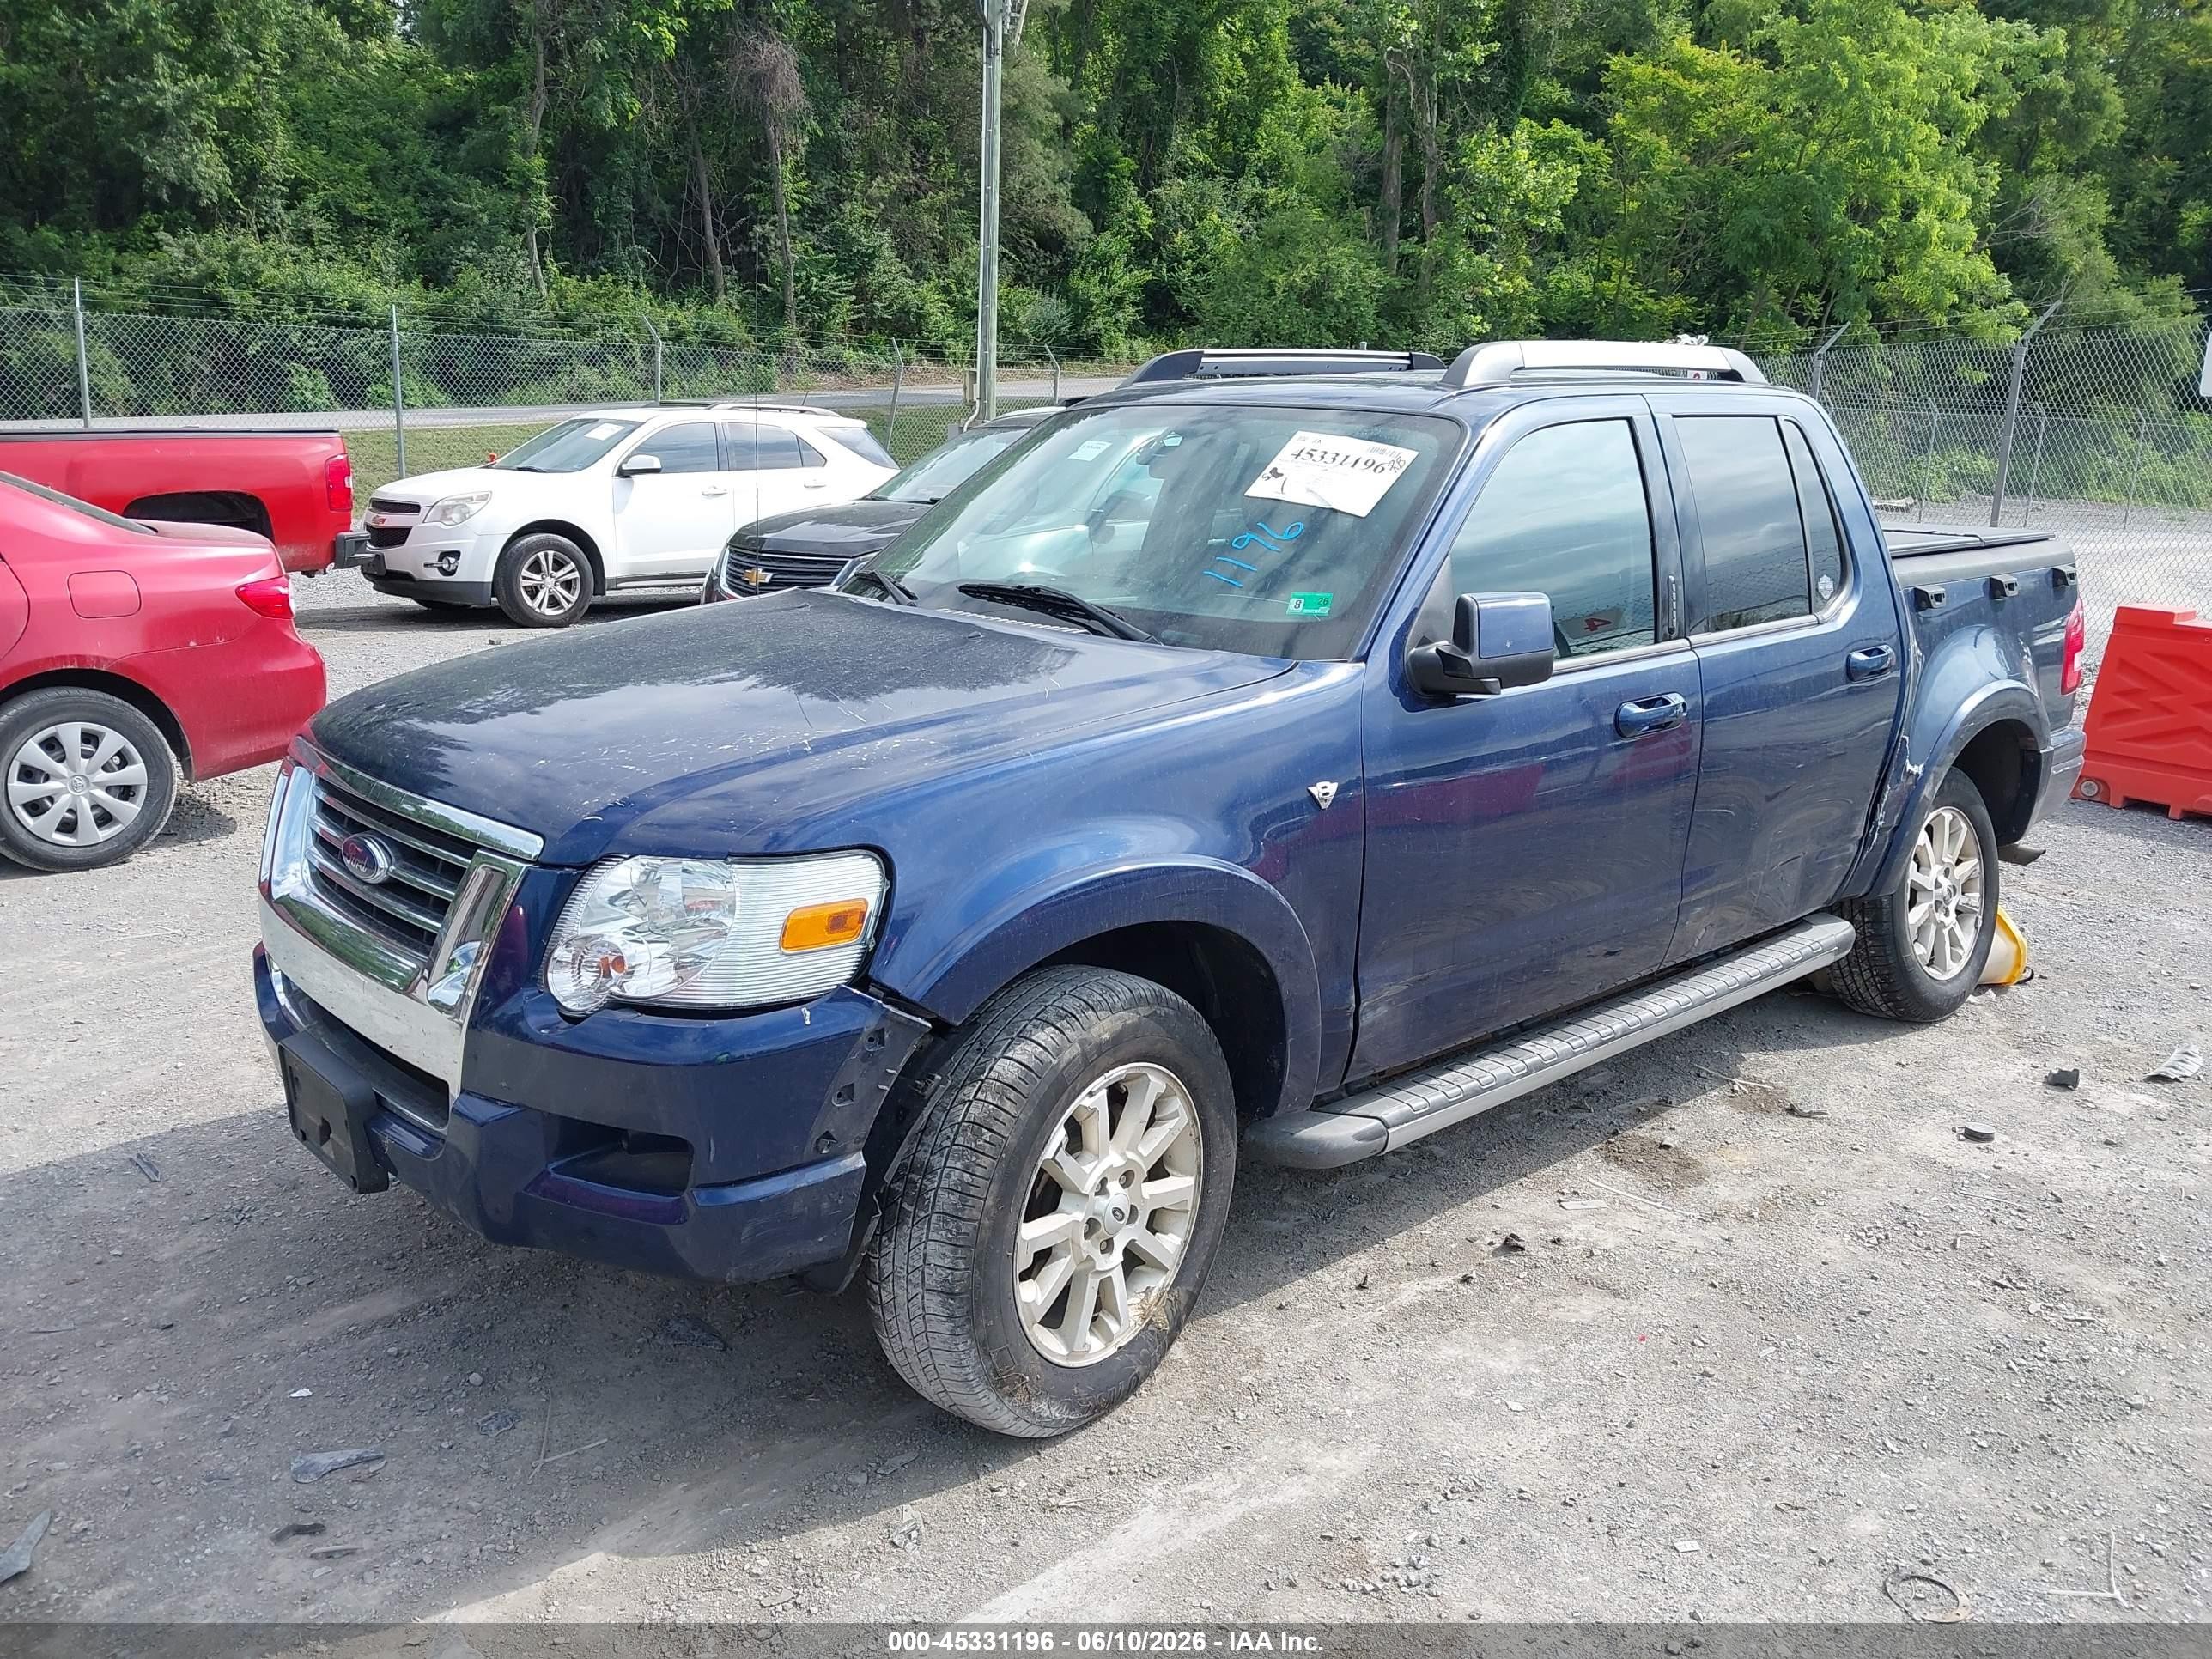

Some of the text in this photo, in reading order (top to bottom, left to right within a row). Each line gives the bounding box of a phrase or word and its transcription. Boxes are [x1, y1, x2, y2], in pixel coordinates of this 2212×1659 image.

[1291, 447, 1385, 474] 45331196
[1203, 522, 1304, 588] 1196
[1293, 599, 1302, 609] 8
[1318, 597, 1328, 605] 26
